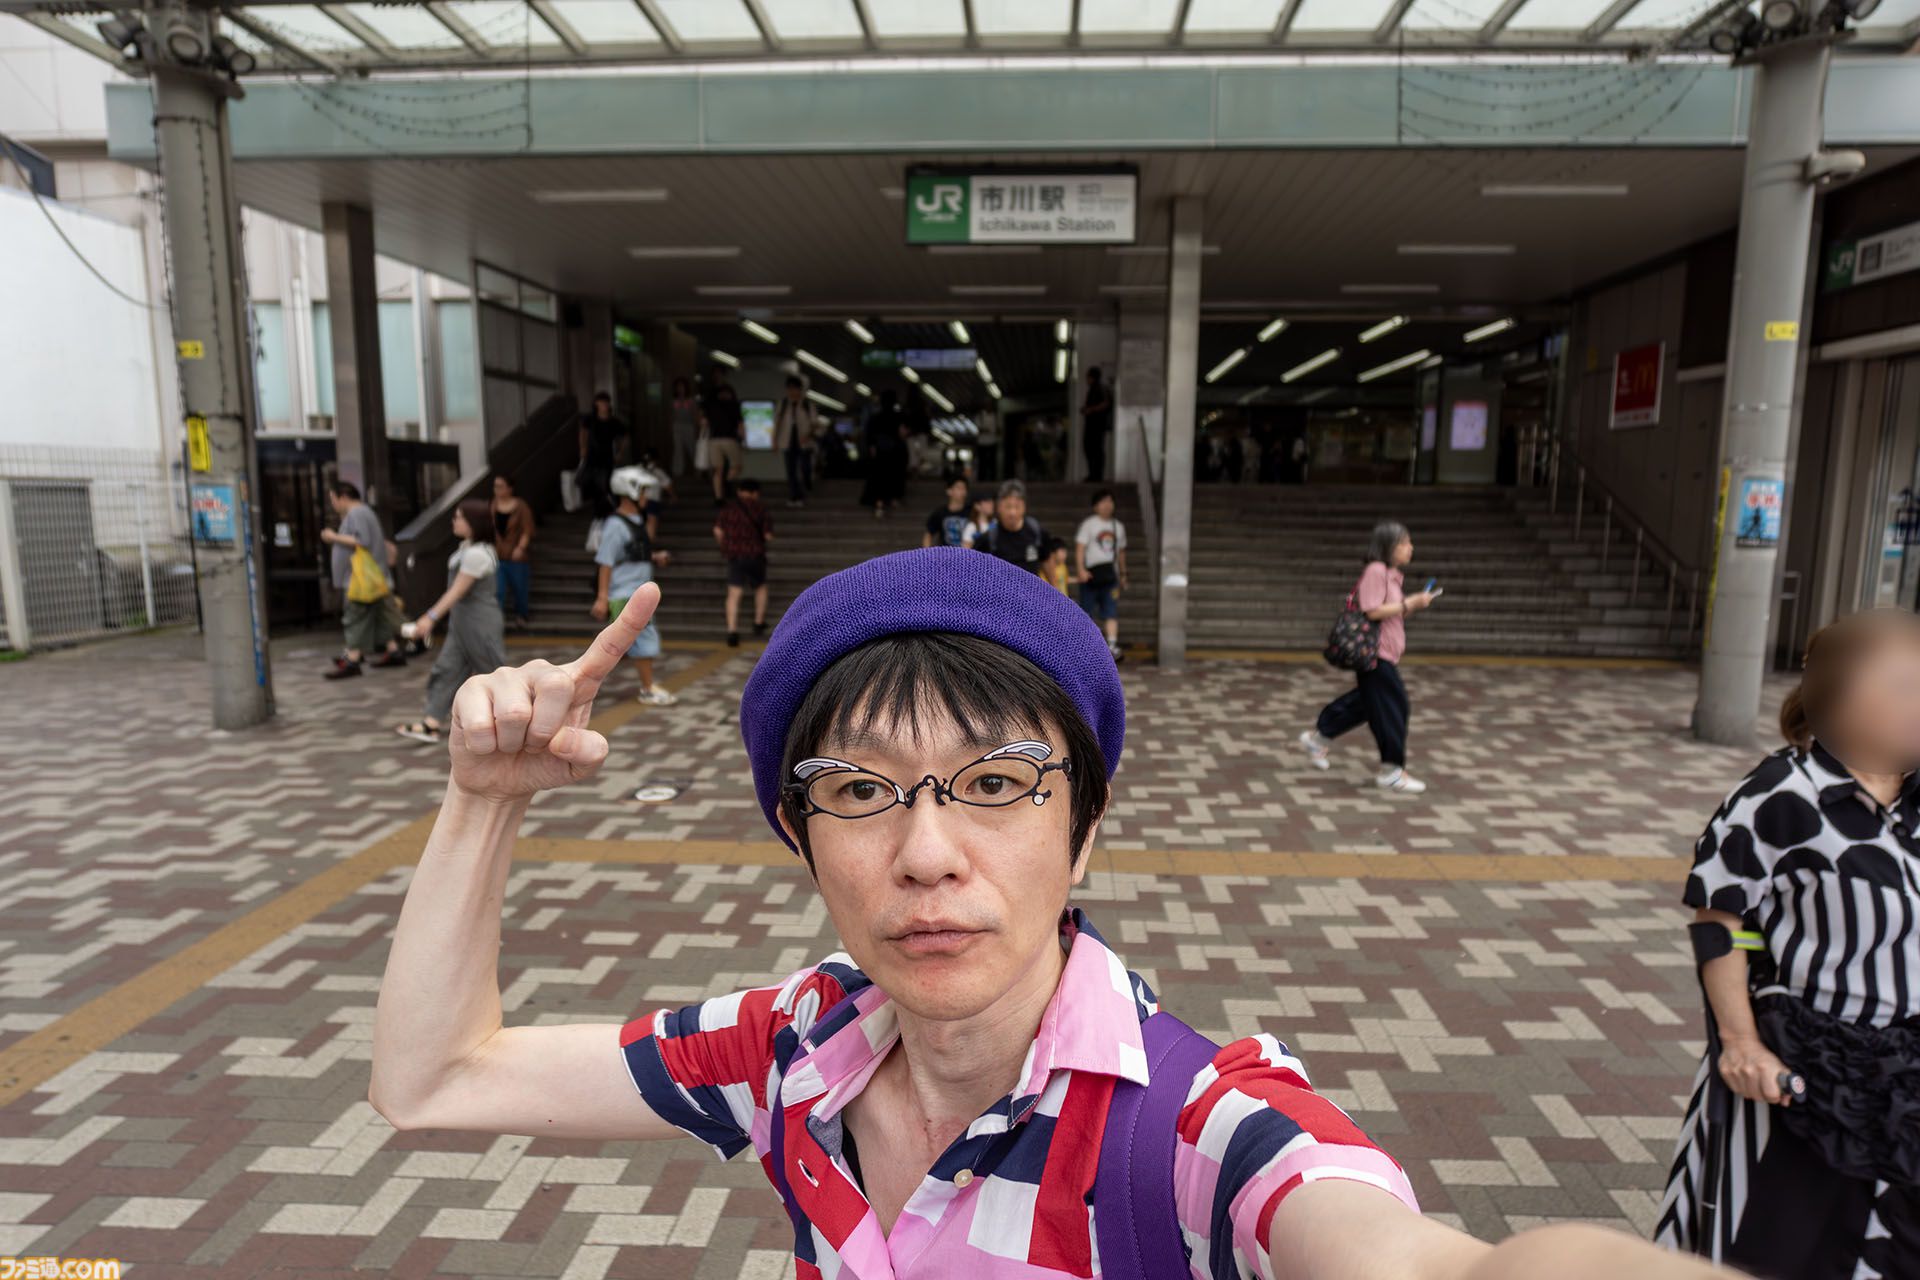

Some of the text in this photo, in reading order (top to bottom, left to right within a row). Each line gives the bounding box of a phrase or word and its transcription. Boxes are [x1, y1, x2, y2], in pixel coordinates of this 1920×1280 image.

[915, 184, 964, 214] JR
[979, 184, 1066, 212] 市川駅
[978, 216, 1116, 233] Ichikawa Station
